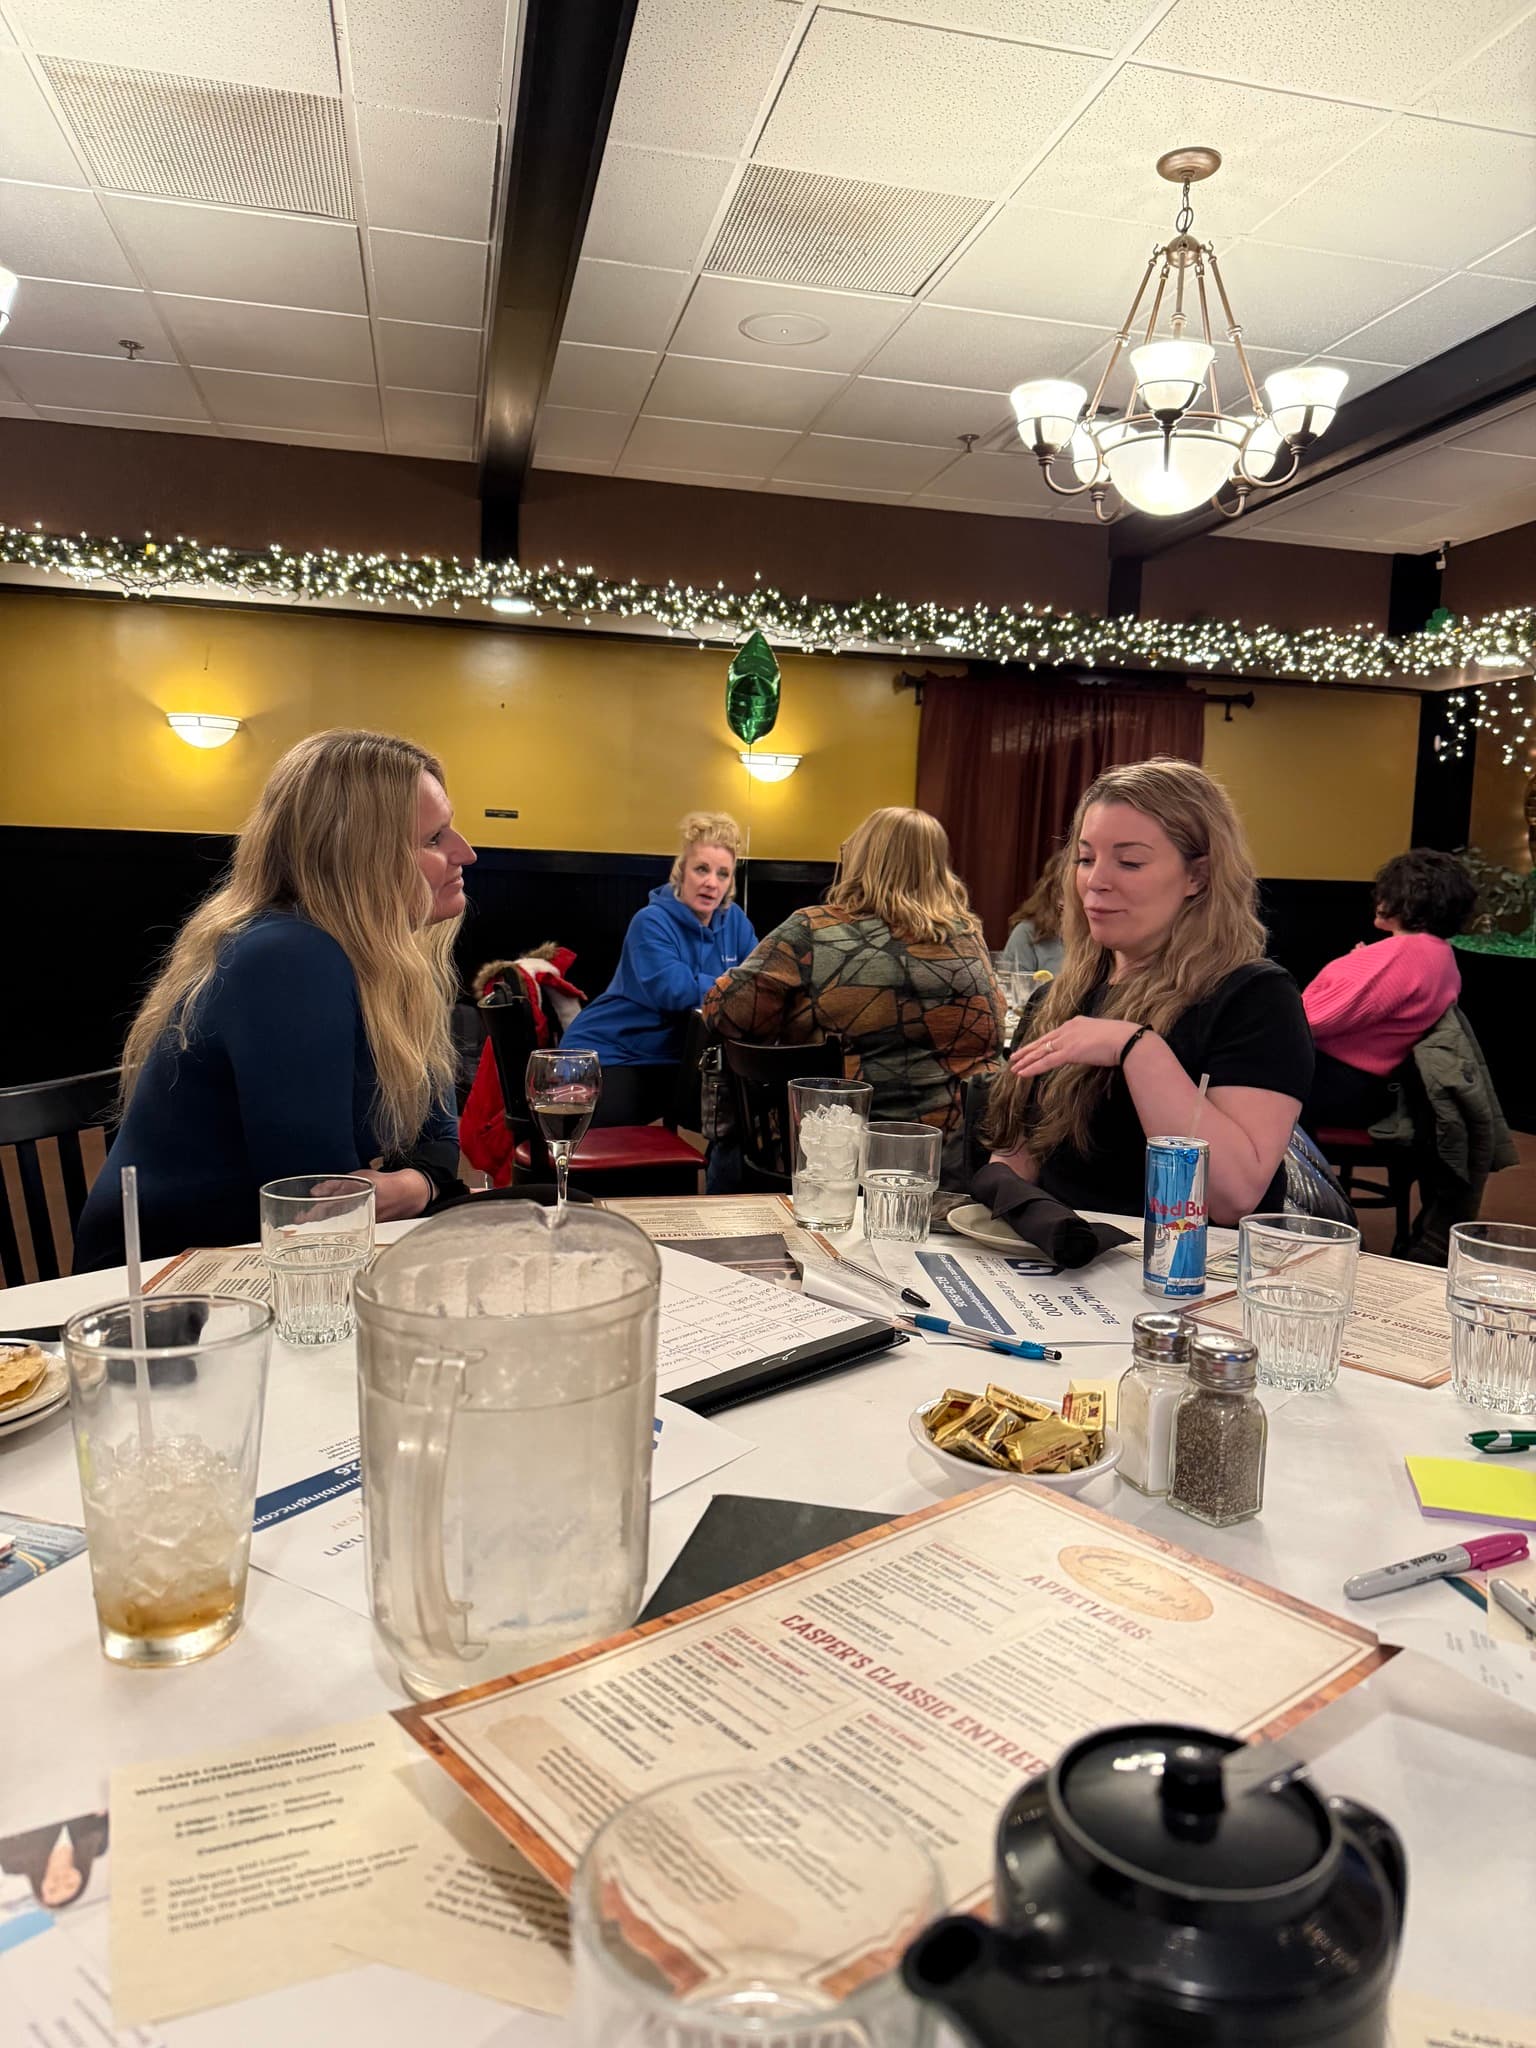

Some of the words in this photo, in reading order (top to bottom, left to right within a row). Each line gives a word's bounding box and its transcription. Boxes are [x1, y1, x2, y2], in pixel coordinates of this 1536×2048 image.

[1150, 1198, 1182, 1216] Red
[1185, 1201, 1208, 1217] Bul
[1028, 1293, 1063, 1317] $2000
[1058, 1295, 1086, 1316] Bonus
[1070, 1285, 1099, 1310] HVAC
[1093, 1304, 1121, 1326] Hiring
[1079, 1553, 1195, 1611] Casper's
[1022, 1572, 1153, 1643] APPETIZERS
[780, 1614, 873, 1670] CASPER'S
[867, 1666, 958, 1722] CLASSIC
[948, 1715, 1050, 1778] ENTREE
